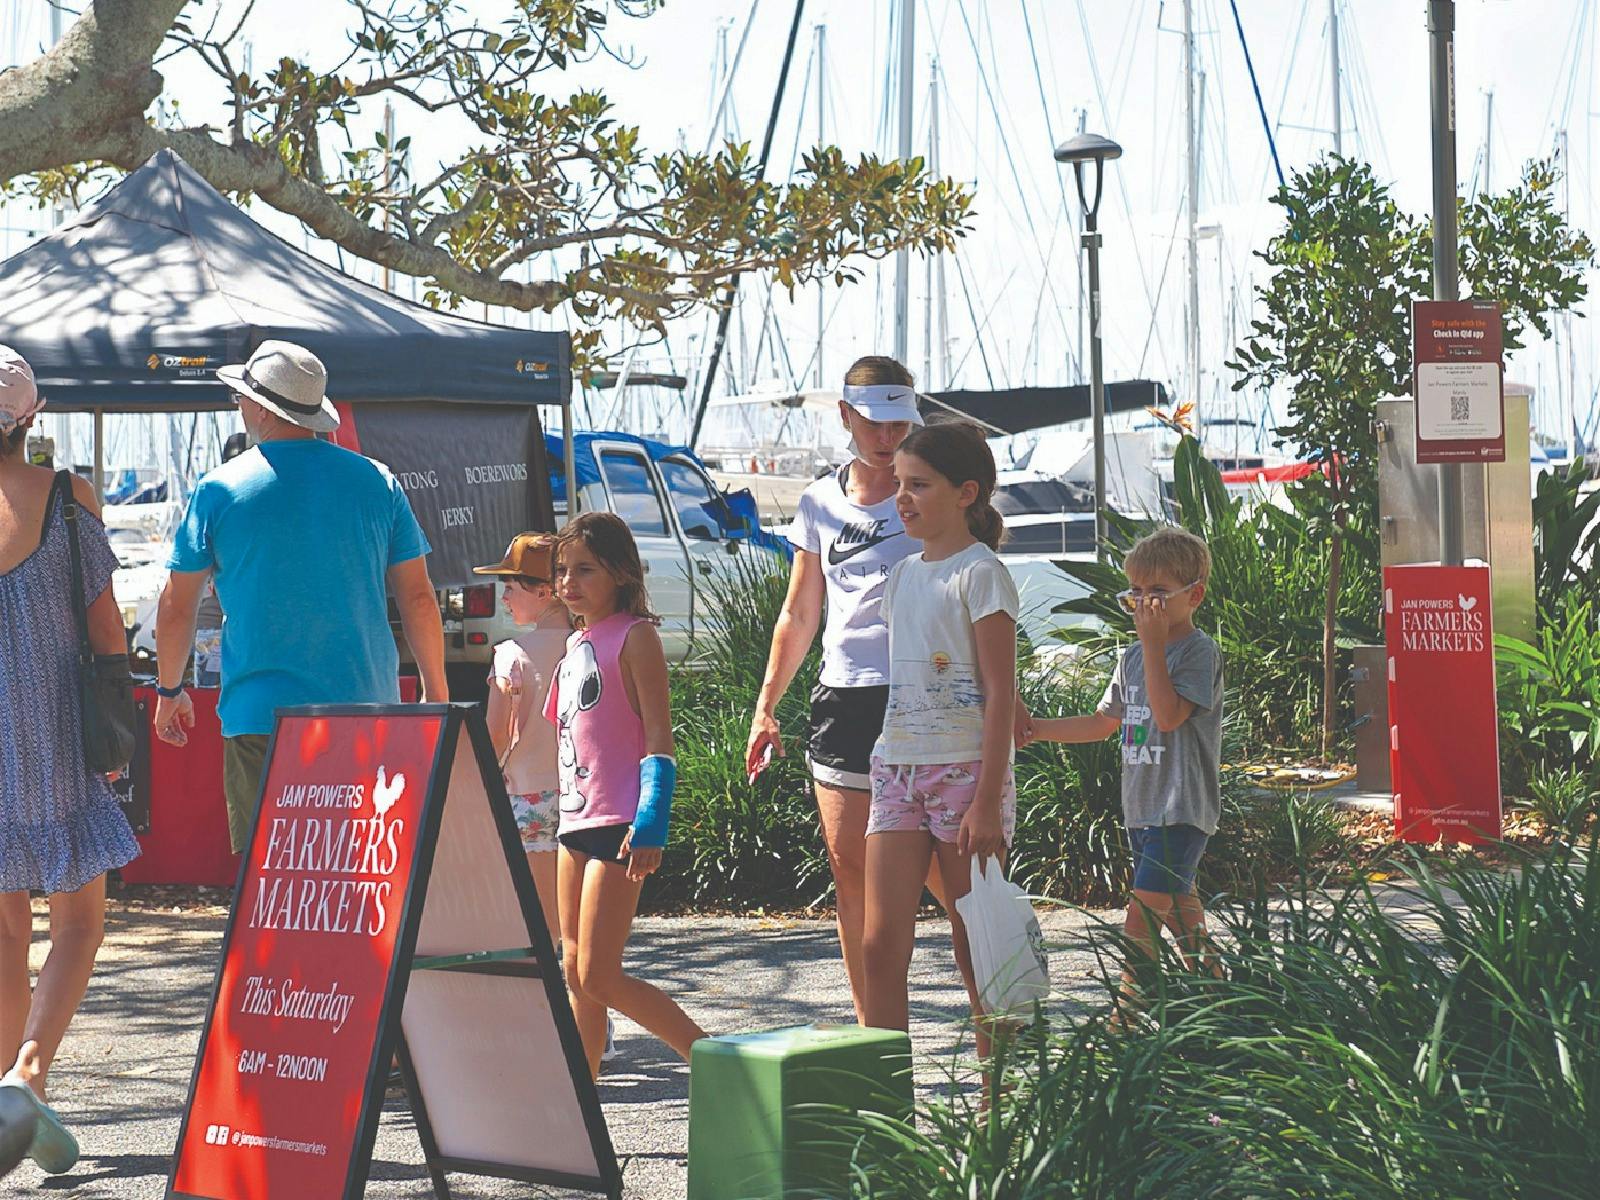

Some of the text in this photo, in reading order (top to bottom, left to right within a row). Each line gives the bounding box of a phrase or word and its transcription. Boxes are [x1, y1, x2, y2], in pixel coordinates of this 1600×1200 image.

[1433, 330, 1452, 338] Check
[395, 463, 528, 490] TONG BOEREWORS
[441, 506, 475, 530] JERKY
[836, 518, 889, 545] NIKE
[840, 564, 888, 581] AIR
[1401, 599, 1454, 609] JAN POWERS
[1401, 611, 1483, 632] FARMERS
[1402, 631, 1484, 652] MARKETS
[276, 784, 365, 810] JAN POWERS
[261, 818, 405, 876] FARMERS
[249, 877, 392, 937] MARKETS
[240, 976, 355, 1034] This Saturday
[237, 1049, 268, 1075] 6AM
[276, 1054, 329, 1082] 12NOON
